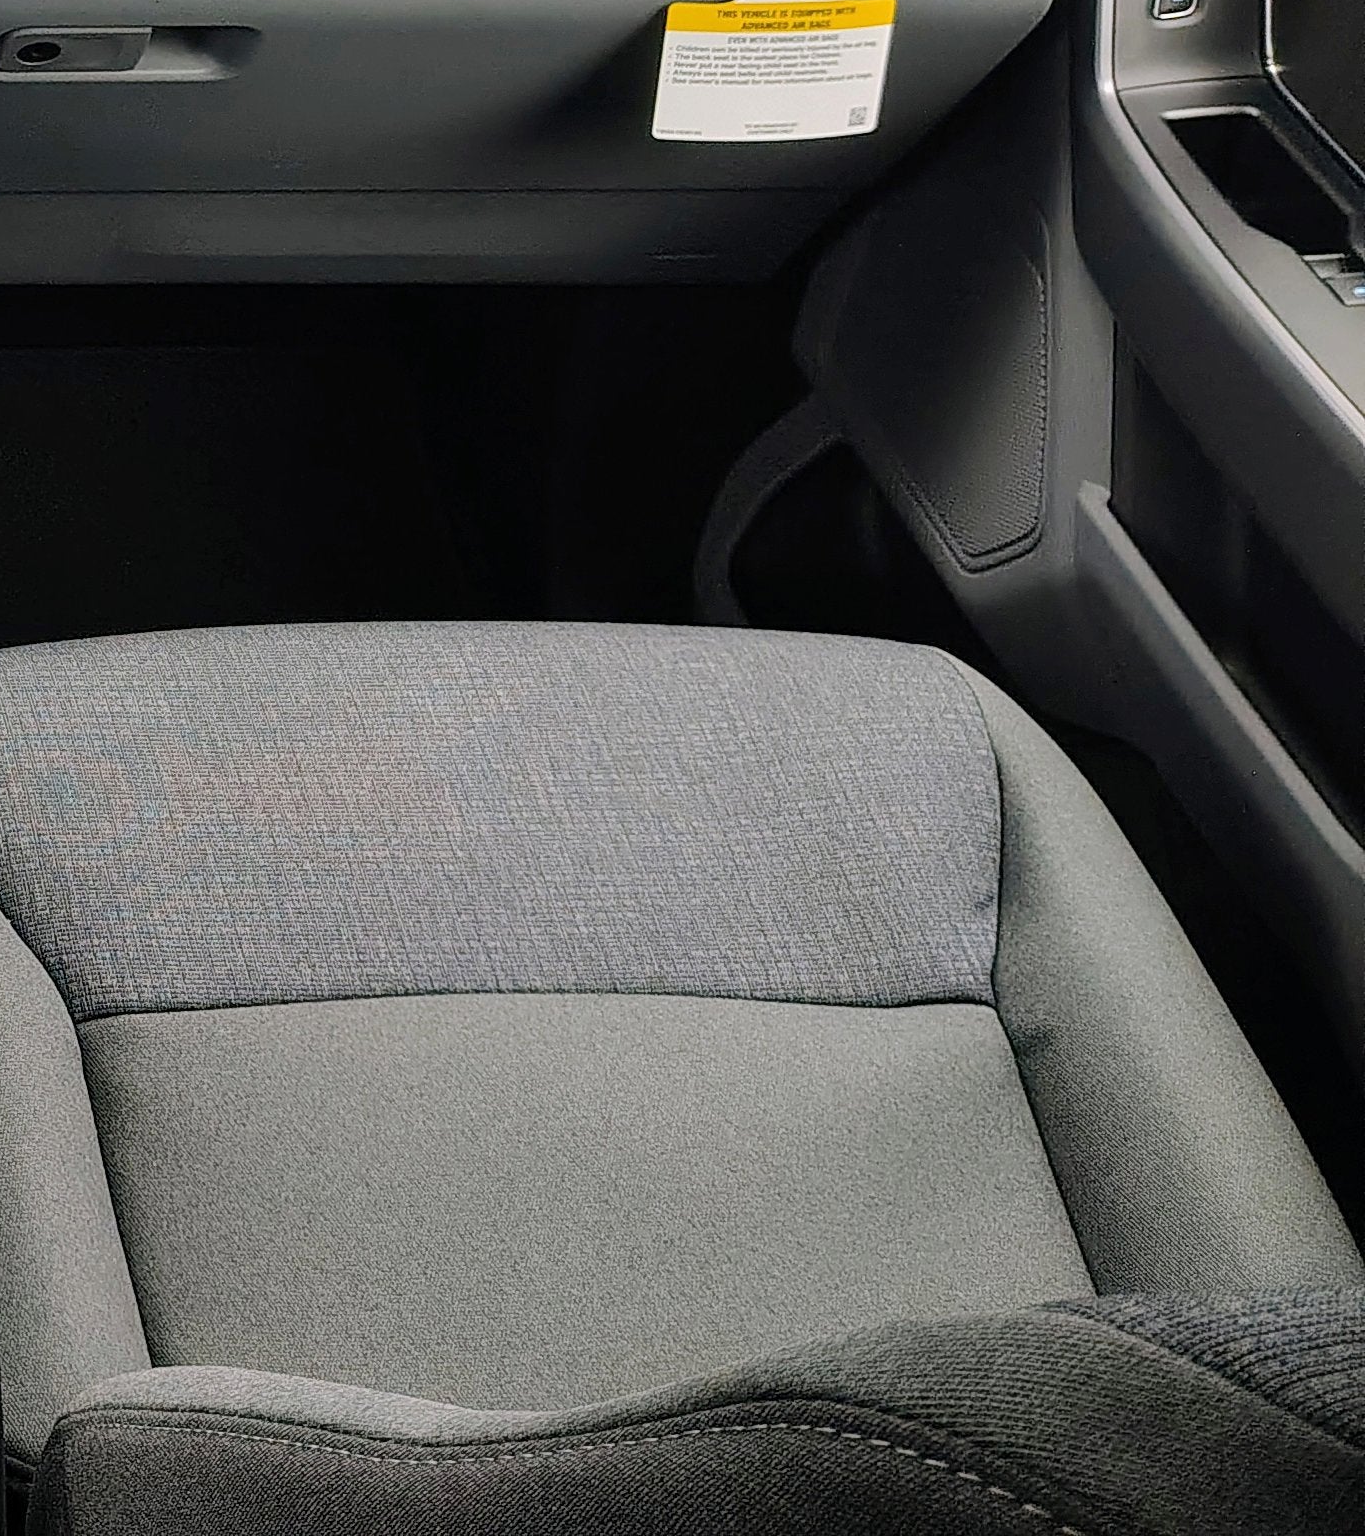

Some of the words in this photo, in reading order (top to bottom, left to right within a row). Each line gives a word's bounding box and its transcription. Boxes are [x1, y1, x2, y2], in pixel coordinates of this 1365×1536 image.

[717, 9, 737, 18] THIS
[741, 9, 776, 19] VEHICLE
[741, 21, 789, 30] ADVANCED
